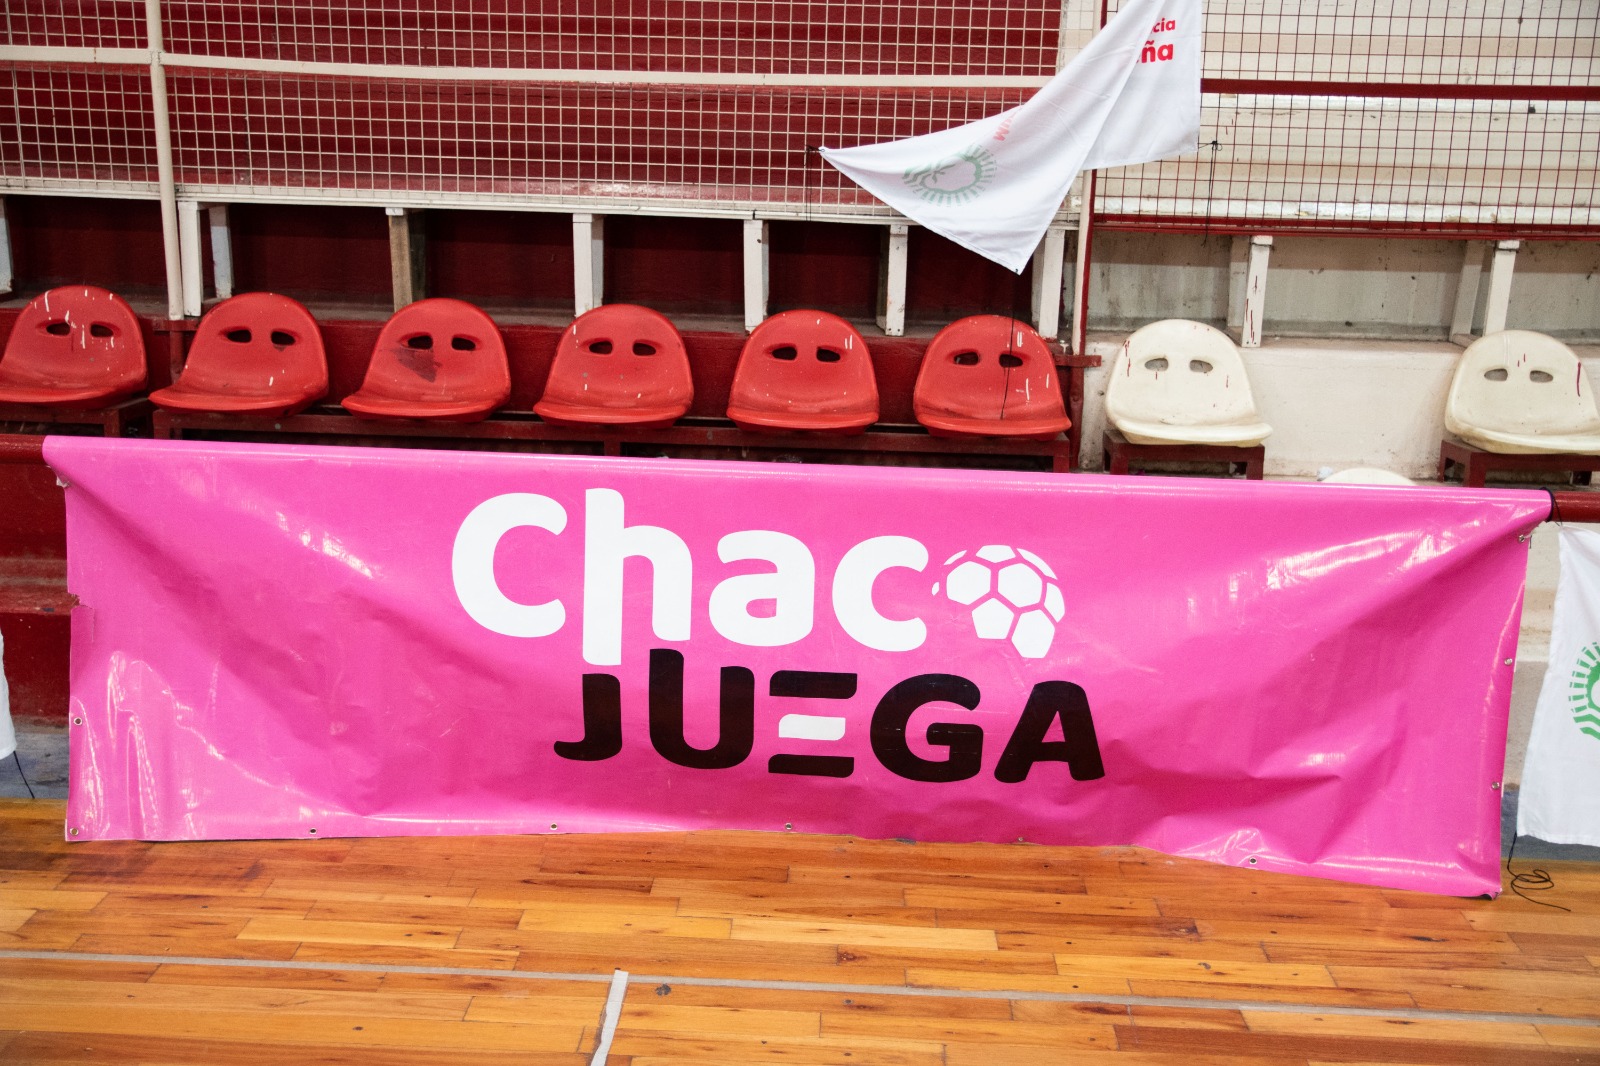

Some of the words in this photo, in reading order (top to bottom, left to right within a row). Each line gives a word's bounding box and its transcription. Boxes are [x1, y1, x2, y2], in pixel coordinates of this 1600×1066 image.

[1151, 17, 1176, 33] cia
[1137, 39, 1174, 64] ña
[553, 648, 1106, 784] JUEGA
